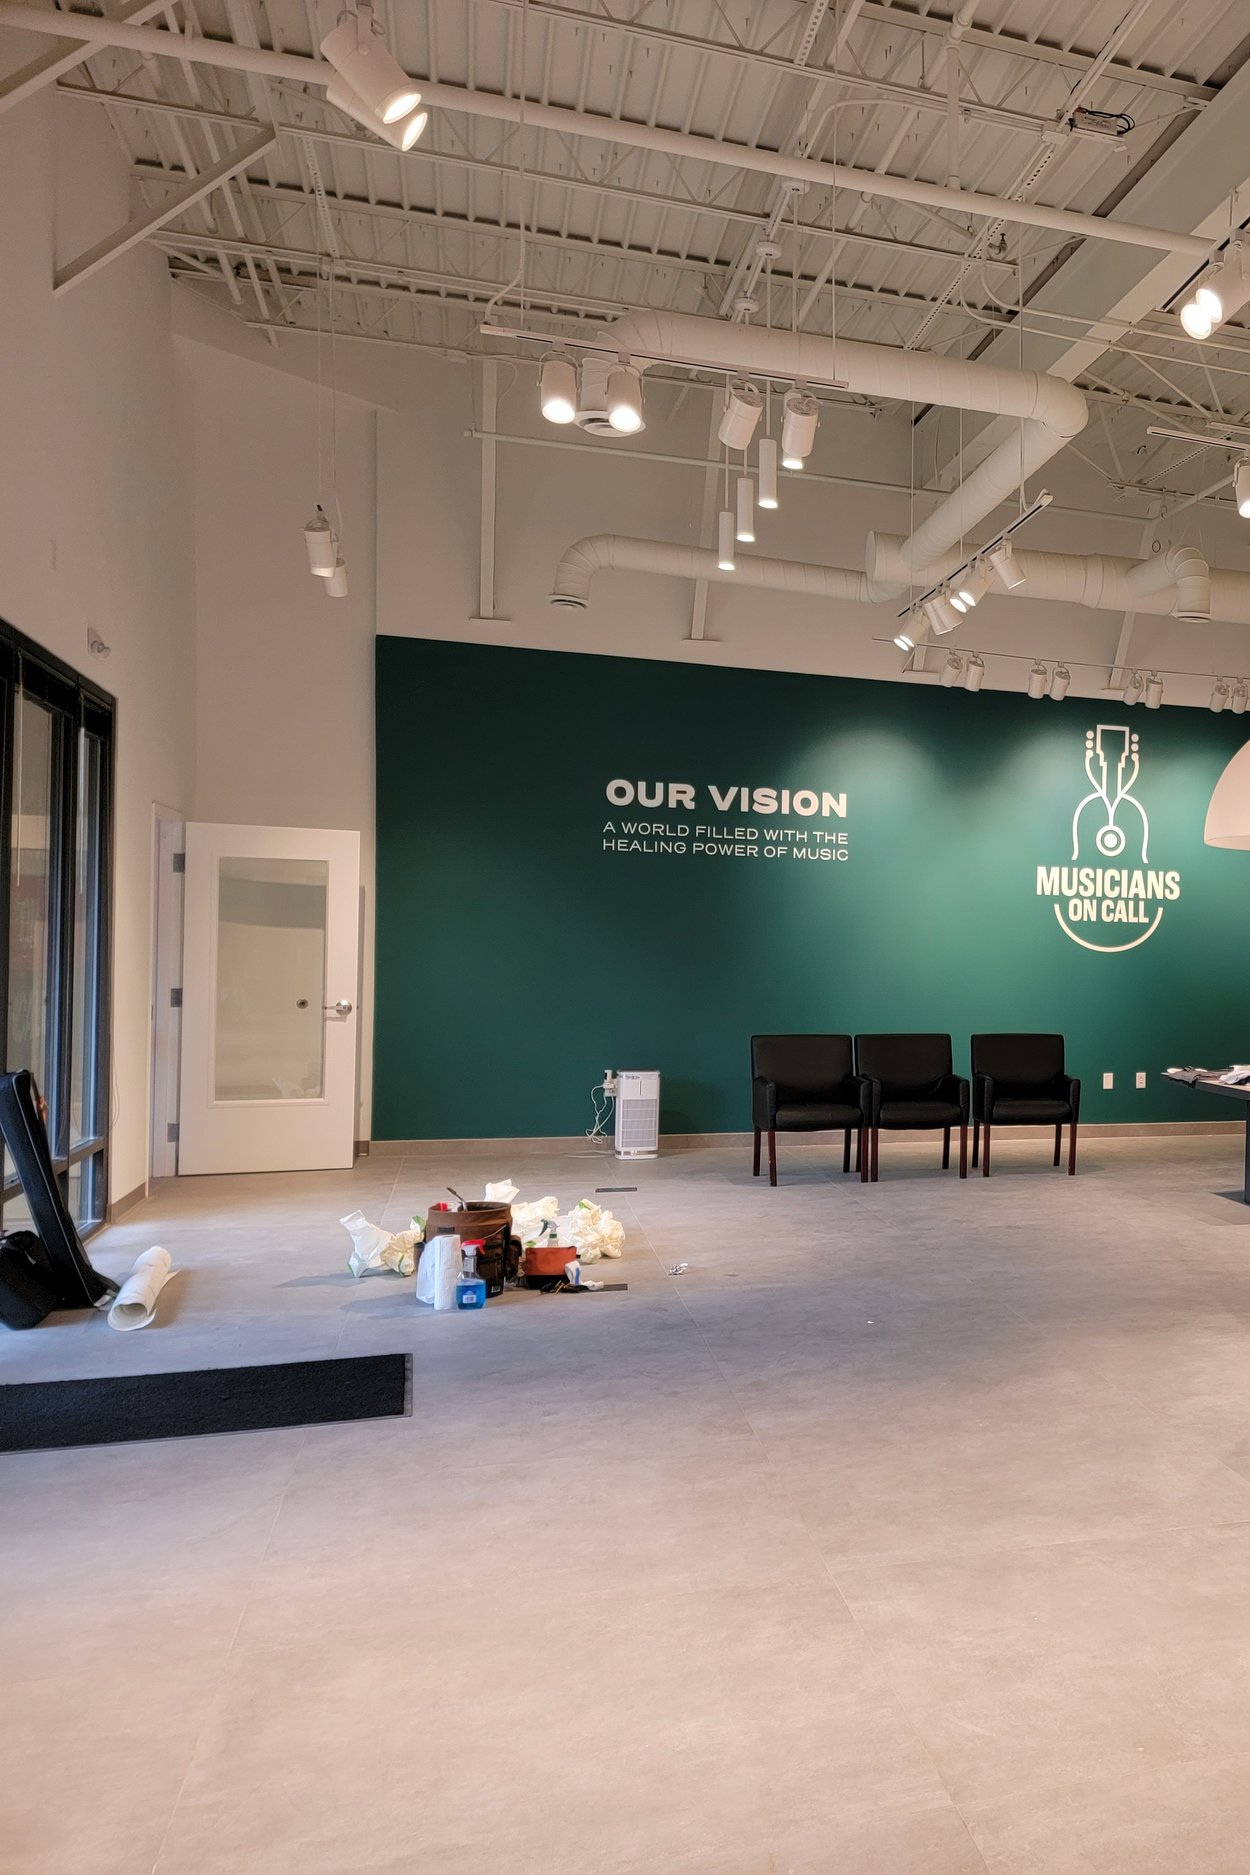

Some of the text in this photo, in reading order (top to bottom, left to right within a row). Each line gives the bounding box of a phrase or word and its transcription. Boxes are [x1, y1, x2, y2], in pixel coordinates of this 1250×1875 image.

[605, 779, 848, 818] OUR VISION
[602, 821, 849, 845] A WORLD FILLED WITH THE
[602, 838, 849, 861] HEALING POWER OF MUSIC
[1036, 865, 1181, 901] MUSICIANS
[1068, 898, 1150, 924] ON CALL
